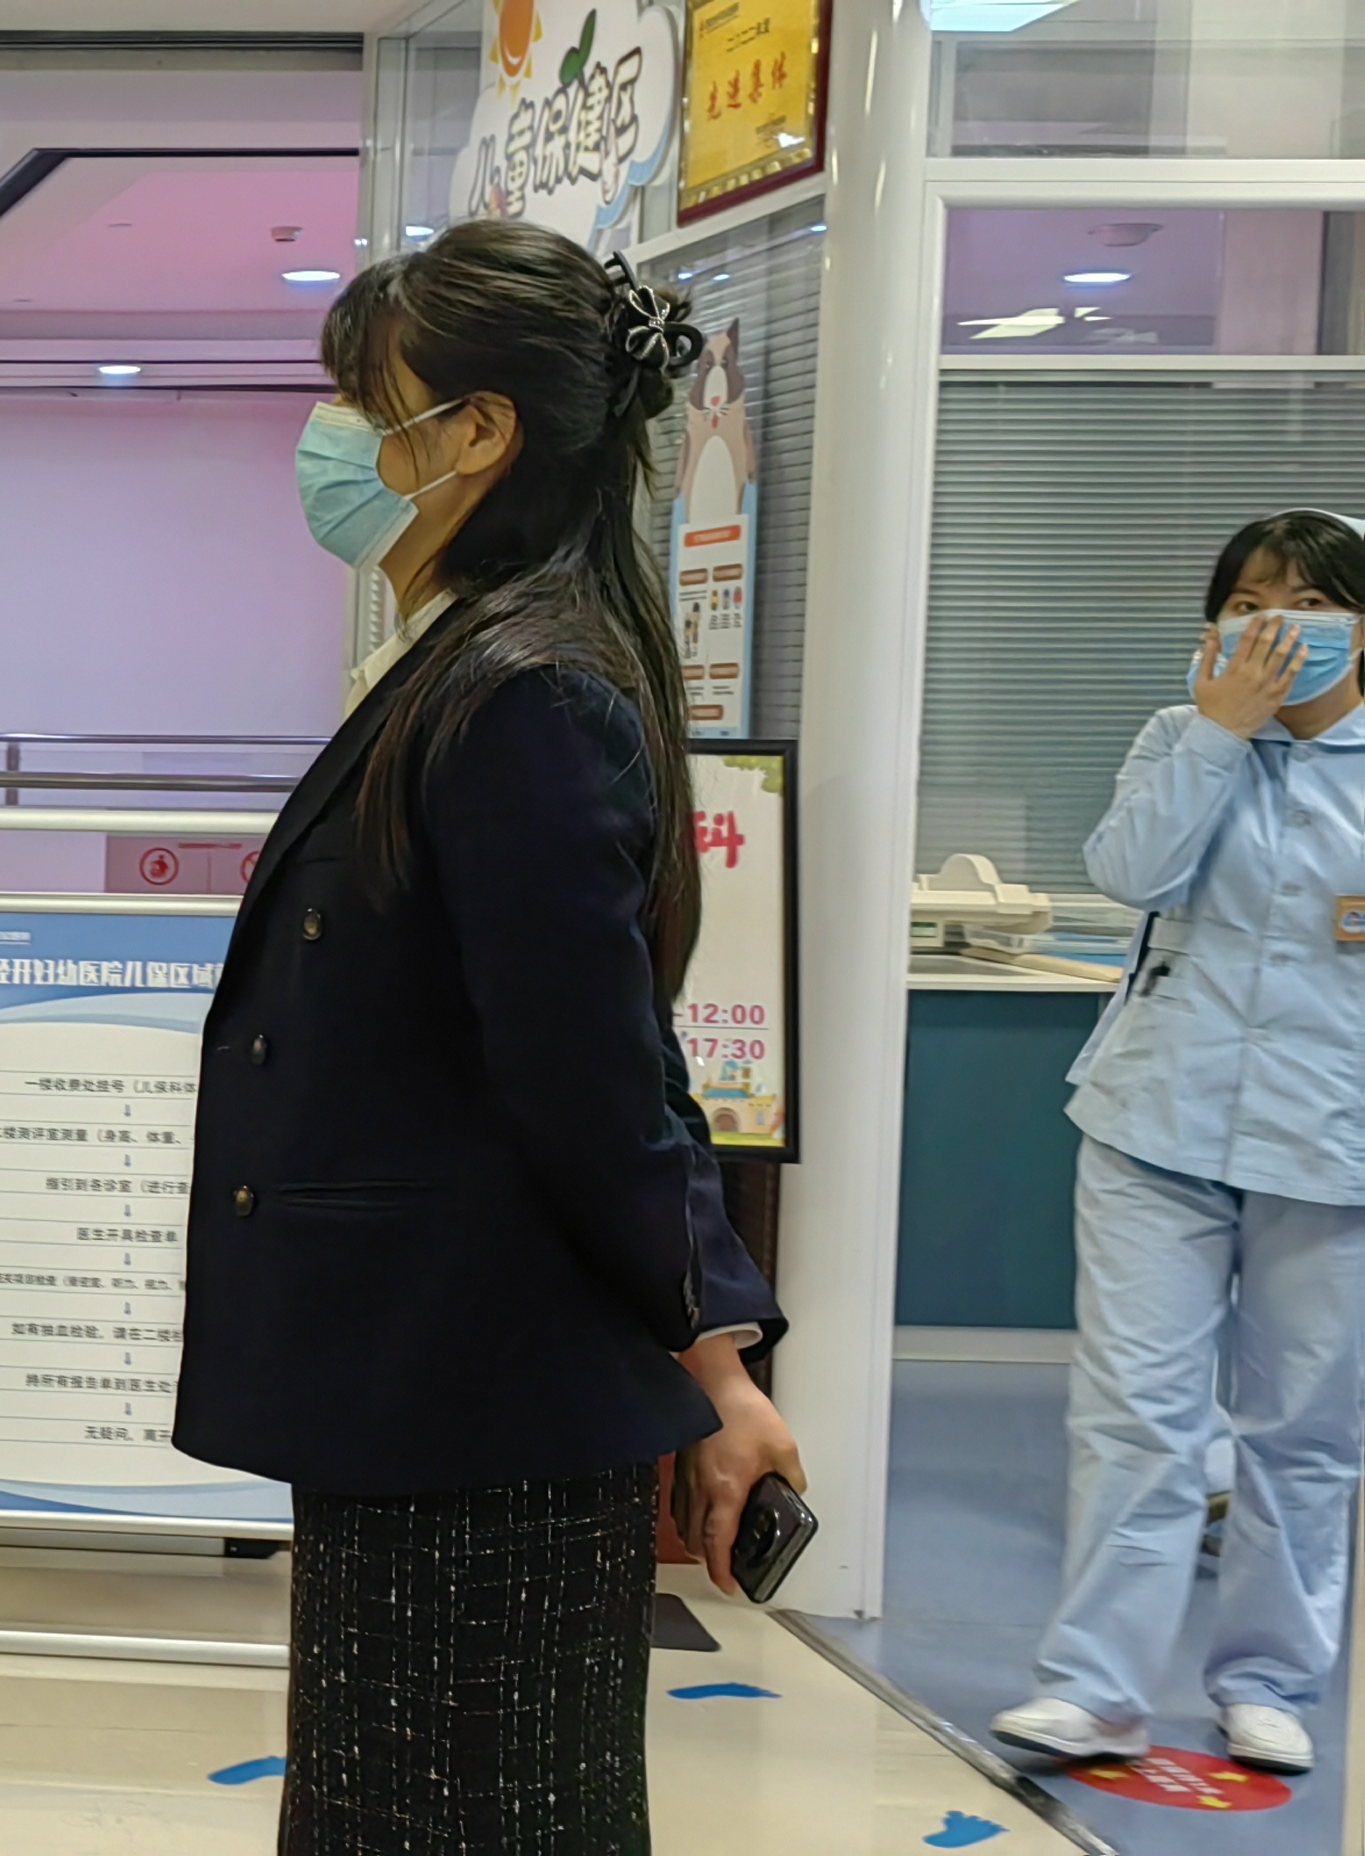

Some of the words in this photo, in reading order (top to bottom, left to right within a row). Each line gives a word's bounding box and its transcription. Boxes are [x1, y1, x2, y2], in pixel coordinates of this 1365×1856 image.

[469, 46, 642, 216] 儿童保健区
[707, 51, 787, 119] 先进集体
